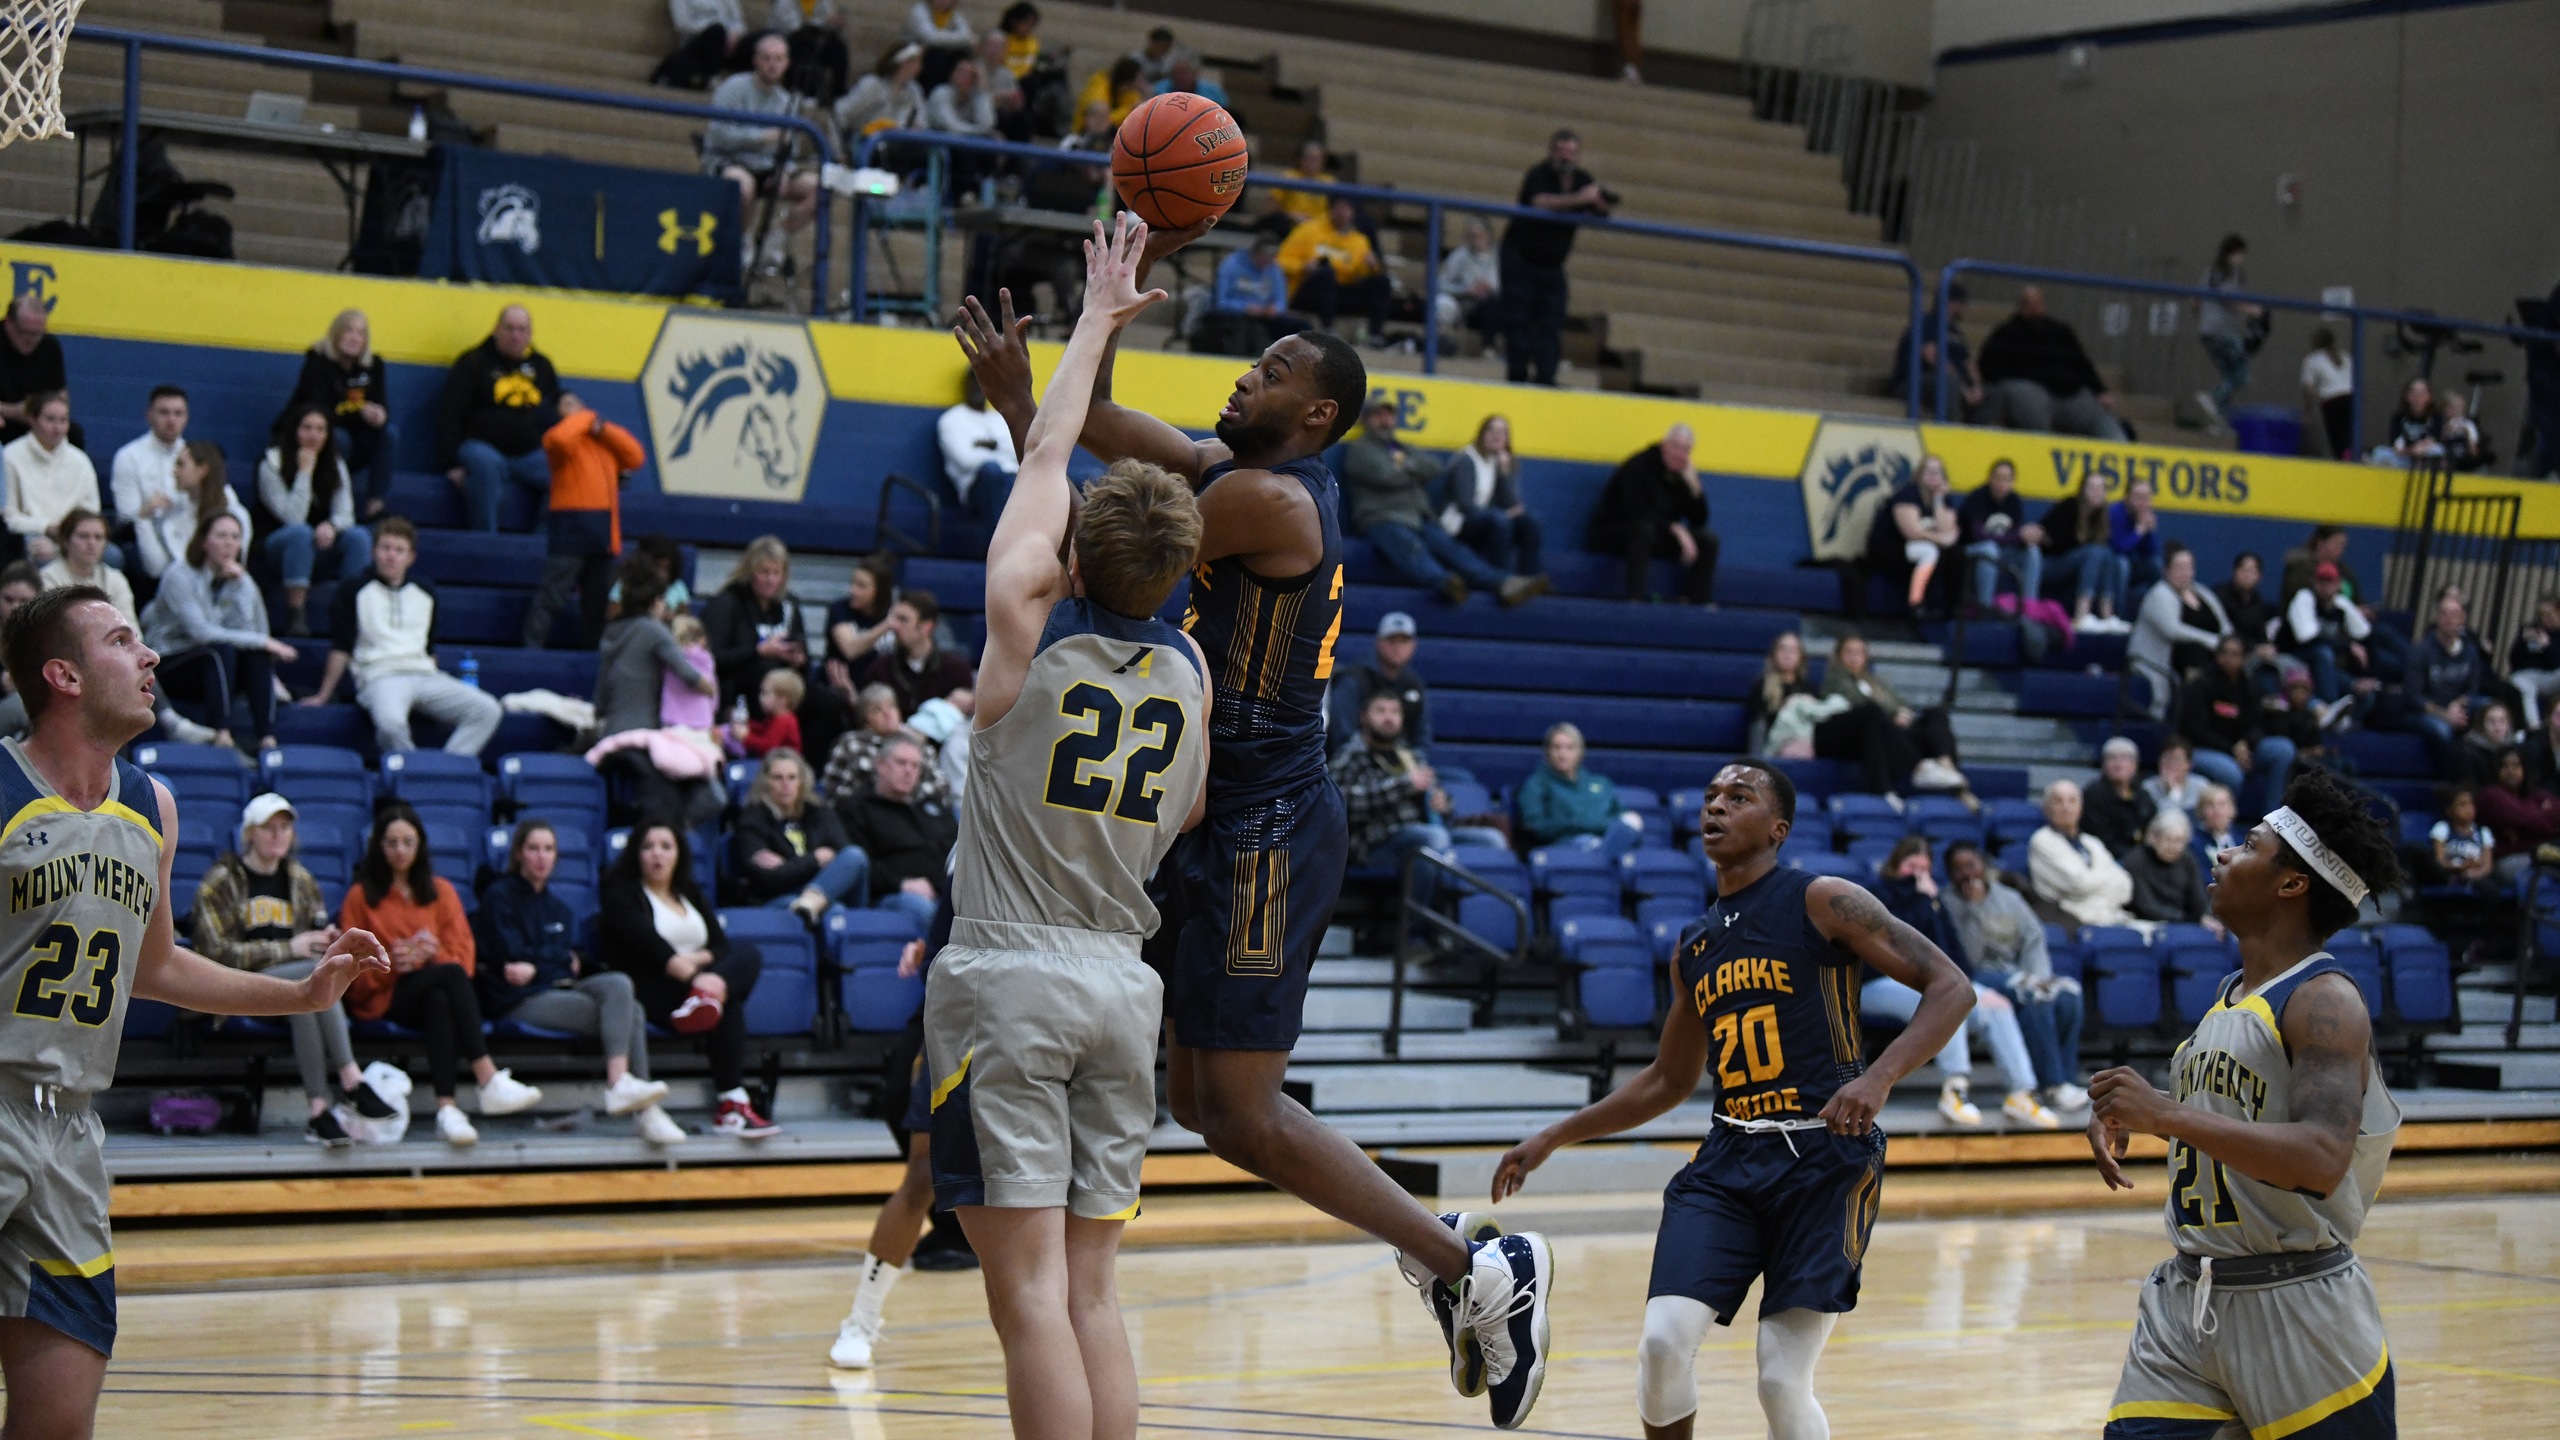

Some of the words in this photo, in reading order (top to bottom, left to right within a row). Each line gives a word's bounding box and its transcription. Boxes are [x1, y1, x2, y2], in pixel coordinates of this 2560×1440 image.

[3, 260, 58, 316] E
[2051, 448, 2249, 504] VISITORS
[1042, 679, 1187, 827] 22
[11, 852, 91, 915] MOUNT
[93, 852, 153, 926] MERCY
[12, 921, 121, 1029] 23
[1694, 957, 1794, 1018] CLARKE
[1712, 1004, 1785, 1090] 20
[2203, 1049, 2268, 1123] MERCY
[2171, 1138, 2240, 1230] 21
